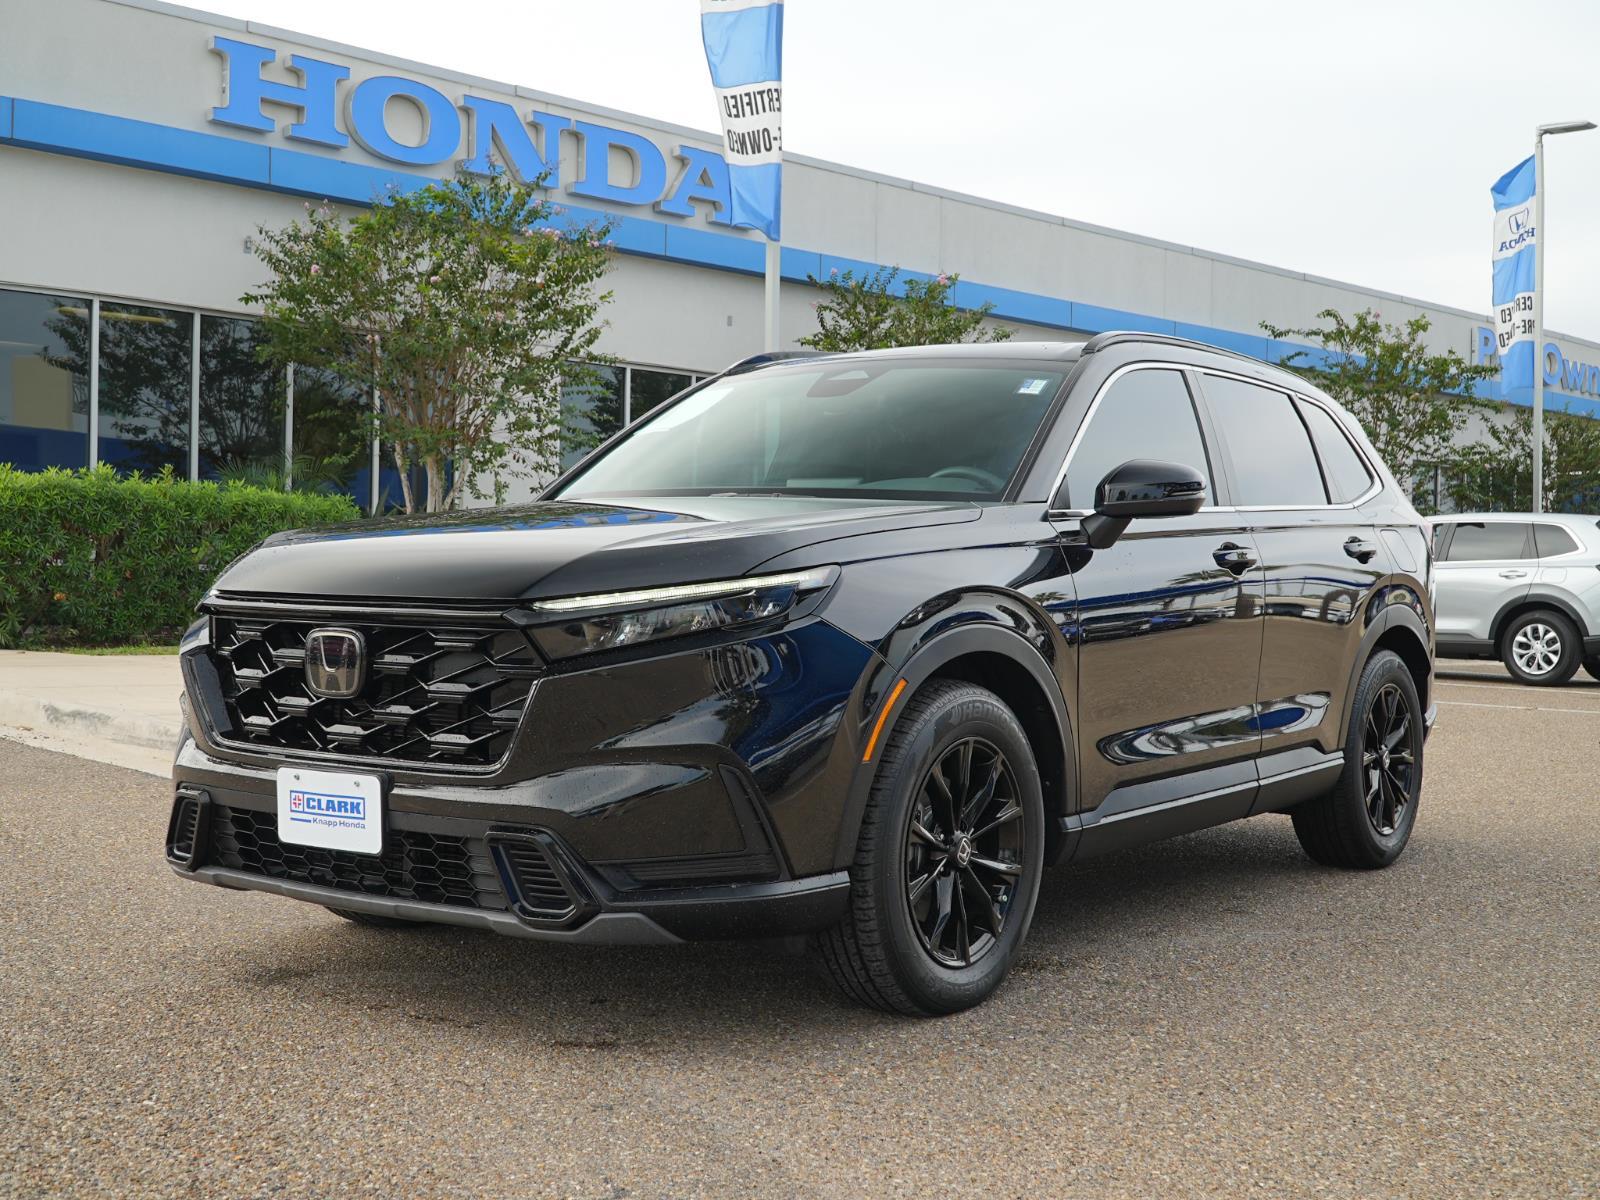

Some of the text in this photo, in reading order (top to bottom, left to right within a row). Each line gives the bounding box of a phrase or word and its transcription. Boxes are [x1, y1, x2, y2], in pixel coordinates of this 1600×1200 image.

[207, 36, 733, 227] HONDA
[306, 797, 361, 814] CLARK
[312, 817, 366, 829] Knapp Honda
